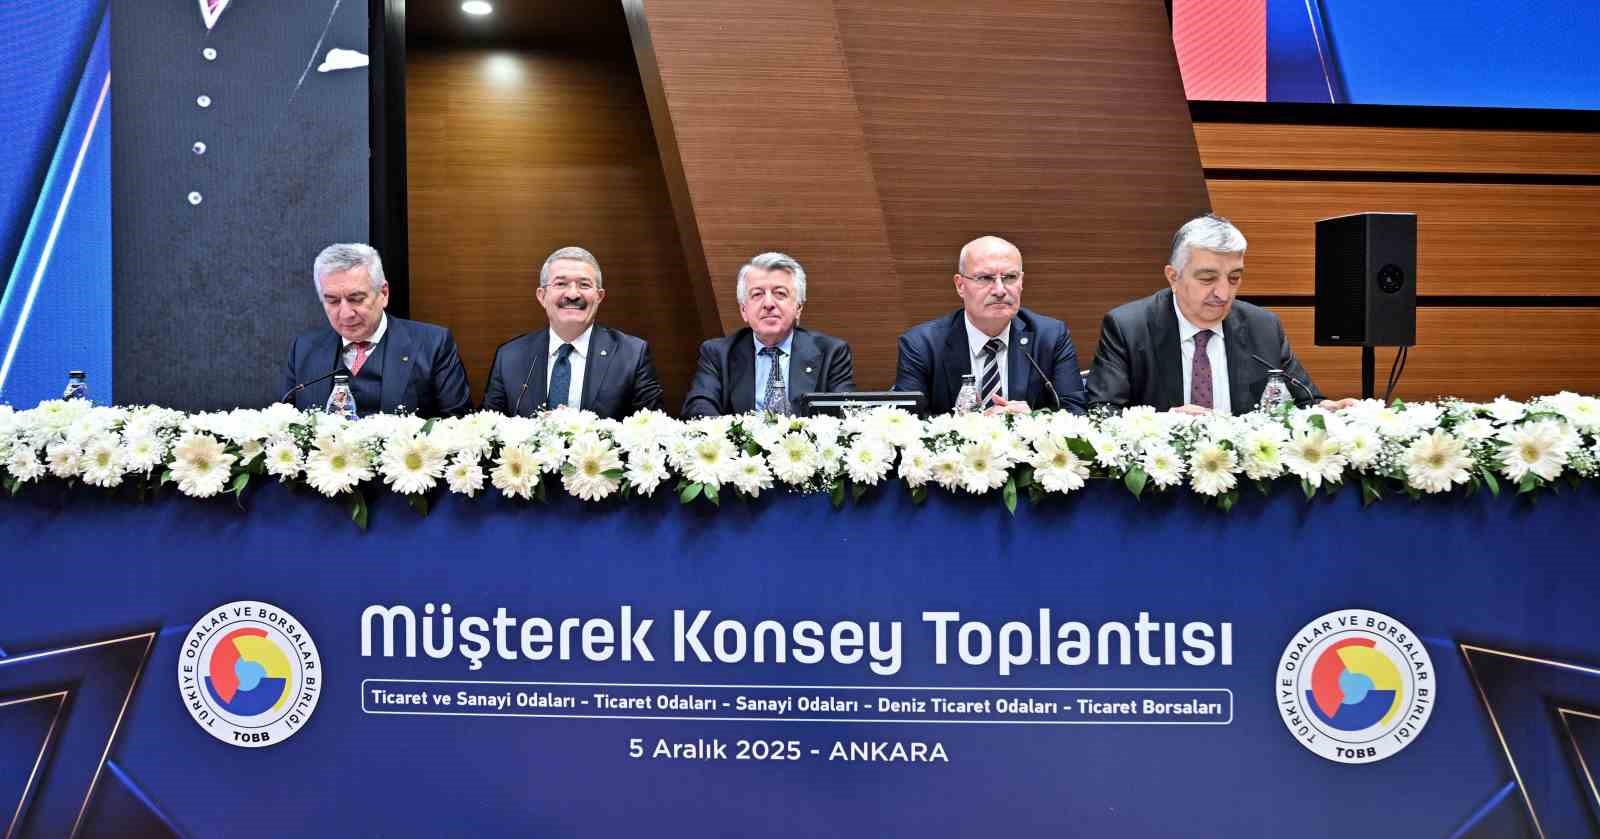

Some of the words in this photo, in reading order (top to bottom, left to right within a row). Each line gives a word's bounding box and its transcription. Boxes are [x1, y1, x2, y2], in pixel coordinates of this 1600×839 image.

[186, 611, 229, 658] ODALAR
[233, 606, 251, 617] VE
[1337, 615, 1358, 627] VE
[258, 608, 315, 670] BORSALAR
[361, 602, 655, 671] Müşterek
[673, 609, 902, 676] Konsey
[922, 607, 1233, 676] Toplantısı
[1286, 621, 1333, 672] ODALAR
[1366, 616, 1428, 681] BORSALAR
[183, 665, 216, 728] TÜRKİYE
[285, 677, 316, 730] BİRLİĞİ
[371, 689, 428, 705] Ticaret
[432, 694, 452, 706] ve
[456, 691, 511, 710] Sanayi
[516, 692, 575, 708] Odaları
[593, 693, 652, 710] Ticaret
[656, 694, 717, 711] Odaları
[735, 695, 792, 715] Sanayi
[797, 696, 858, 712] Odaları
[878, 697, 926, 713] Deniz
[930, 698, 991, 713] Ticaret
[995, 698, 1058, 714] Odaları
[1076, 698, 1137, 714] Ticaret
[1142, 698, 1222, 715] Borsaları
[1281, 678, 1316, 744] TÜRKİYE
[1393, 688, 1429, 744] BİRLİĞİ
[232, 731, 271, 743] TOBB
[629, 738, 644, 758] 5
[652, 738, 727, 760] Aralık
[735, 739, 801, 761] 2025
[828, 741, 949, 762] ANKARA
[1335, 747, 1377, 759] TOBB
